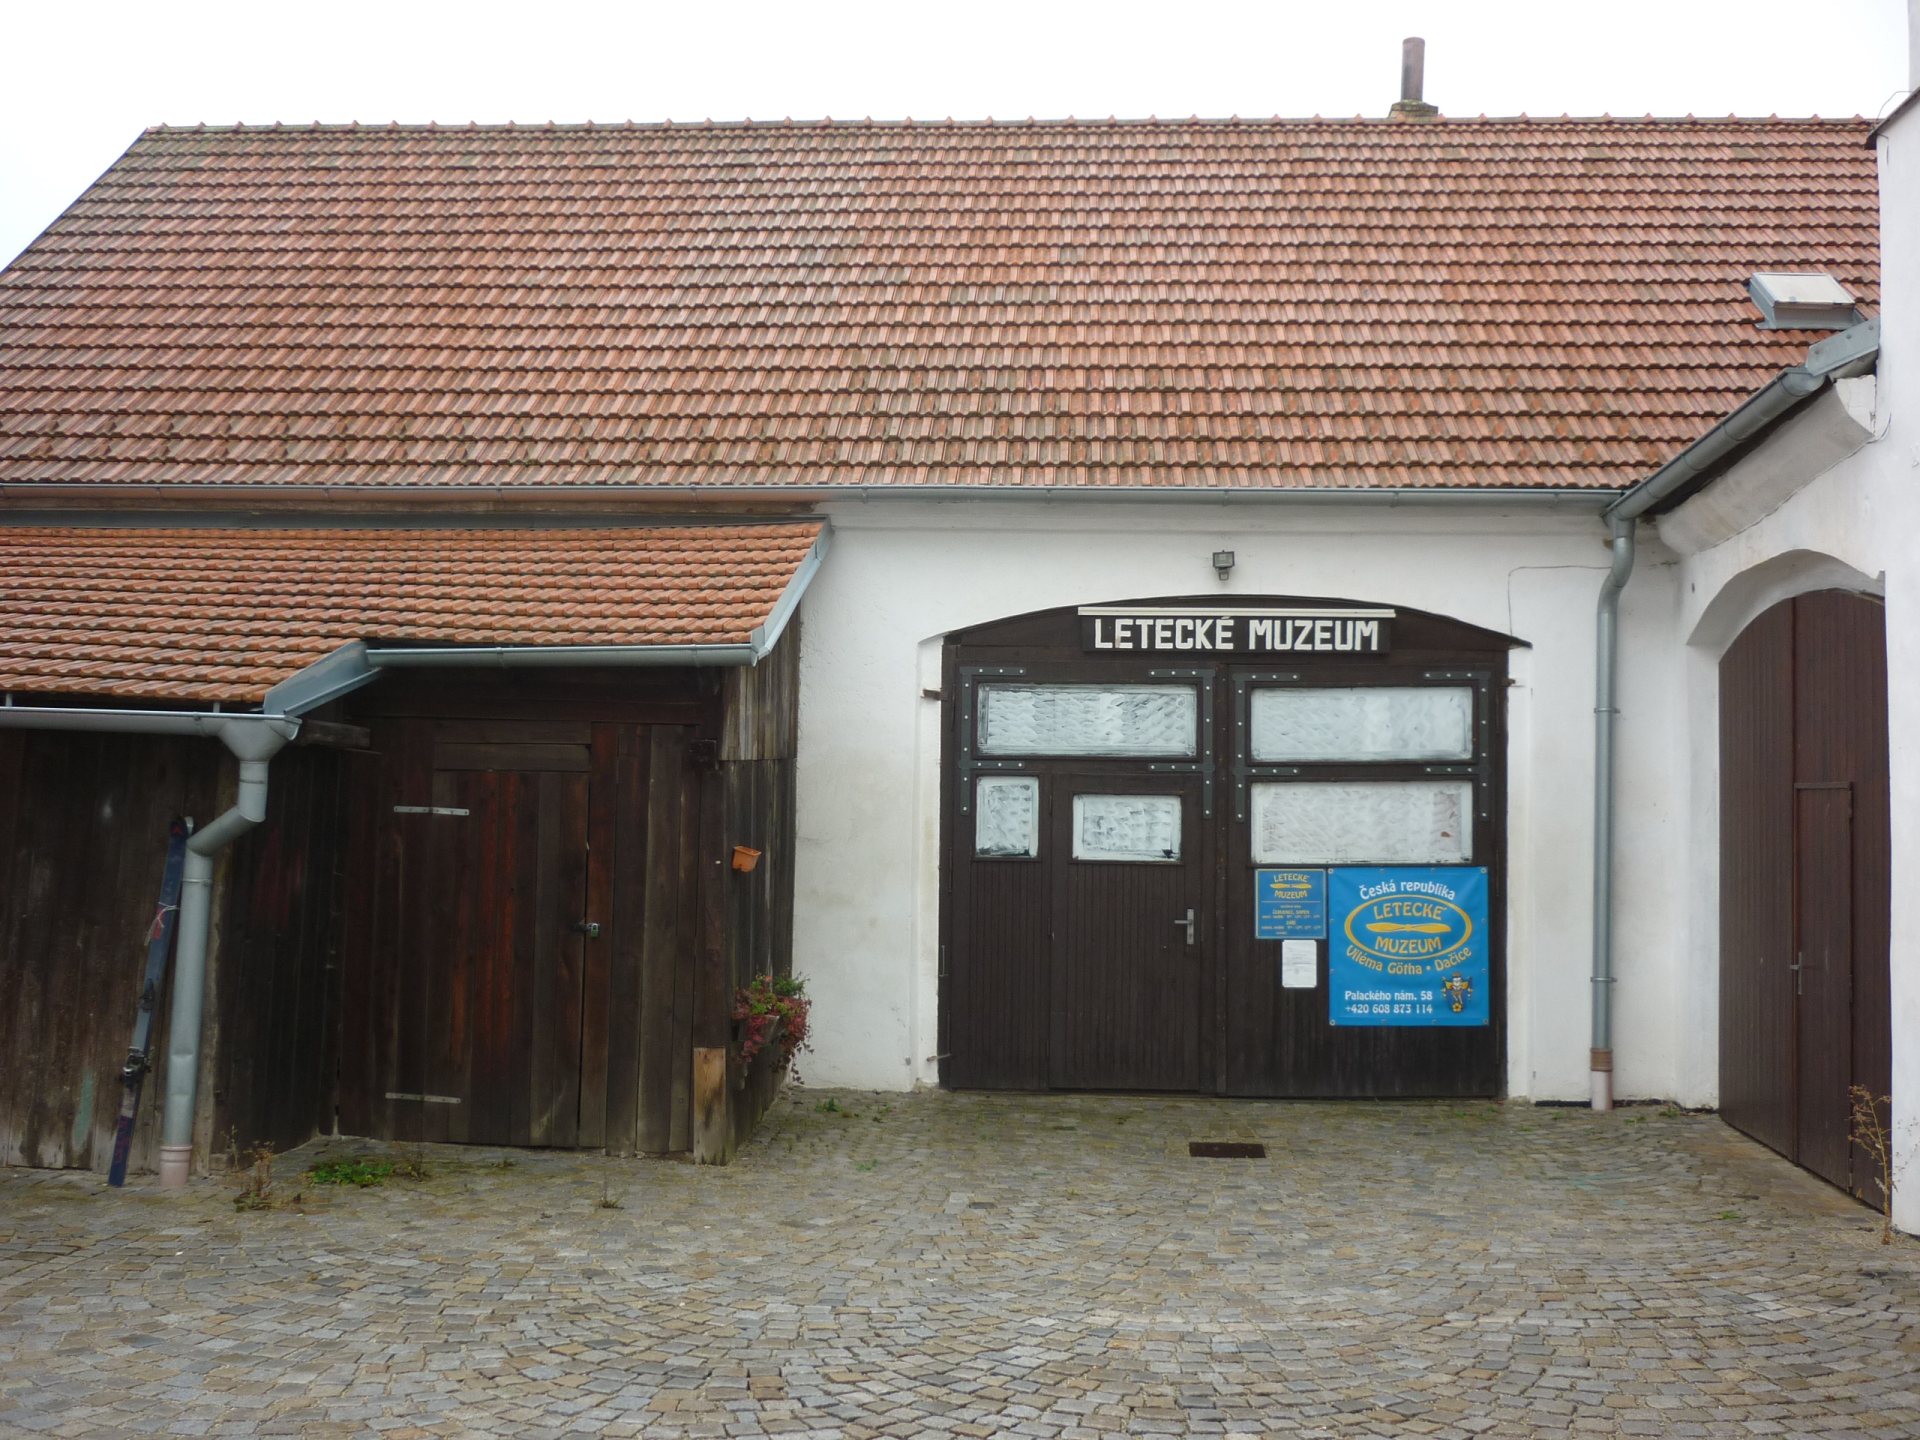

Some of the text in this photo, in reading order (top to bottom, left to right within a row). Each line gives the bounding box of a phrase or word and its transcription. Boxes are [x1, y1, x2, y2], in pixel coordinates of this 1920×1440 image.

[1094, 616, 1379, 651] LETECKÉ MUZEUM
[1274, 890, 1308, 899] MUZEUM
[1359, 879, 1456, 900] Česká republika
[1373, 901, 1447, 920] LETECKÉ
[1375, 936, 1442, 954] MUZEUM
[1434, 947, 1472, 972] Dačice
[1344, 990, 1433, 1001] Palackého nám. 58
[1345, 1004, 1433, 1014] +420 608 873 114
